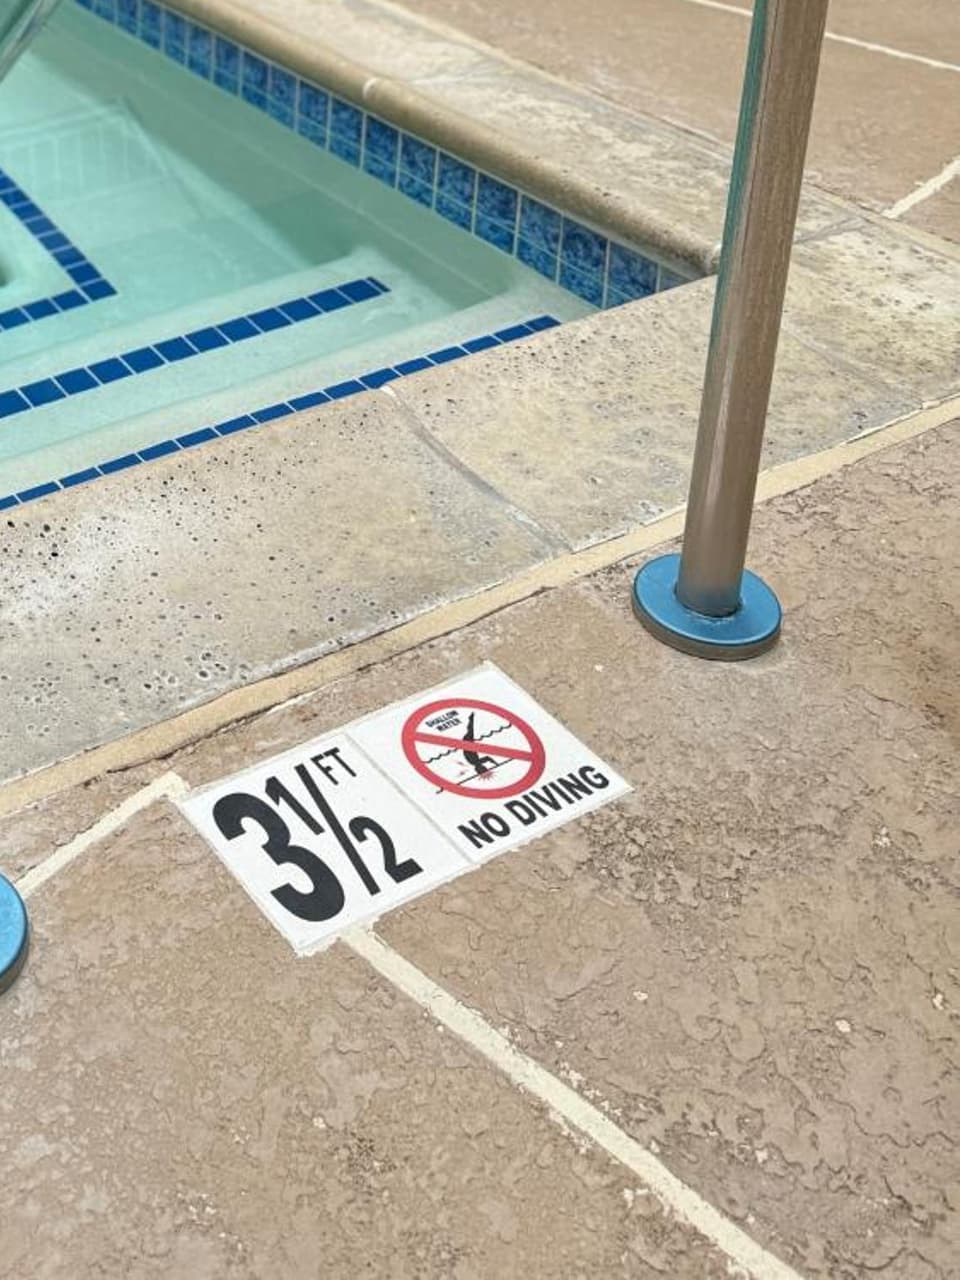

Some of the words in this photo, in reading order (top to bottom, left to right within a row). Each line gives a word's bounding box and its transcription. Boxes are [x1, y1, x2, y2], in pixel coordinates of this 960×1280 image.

[310, 747, 357, 786] FT
[457, 811, 511, 849] NO
[504, 765, 610, 826] DIVING
